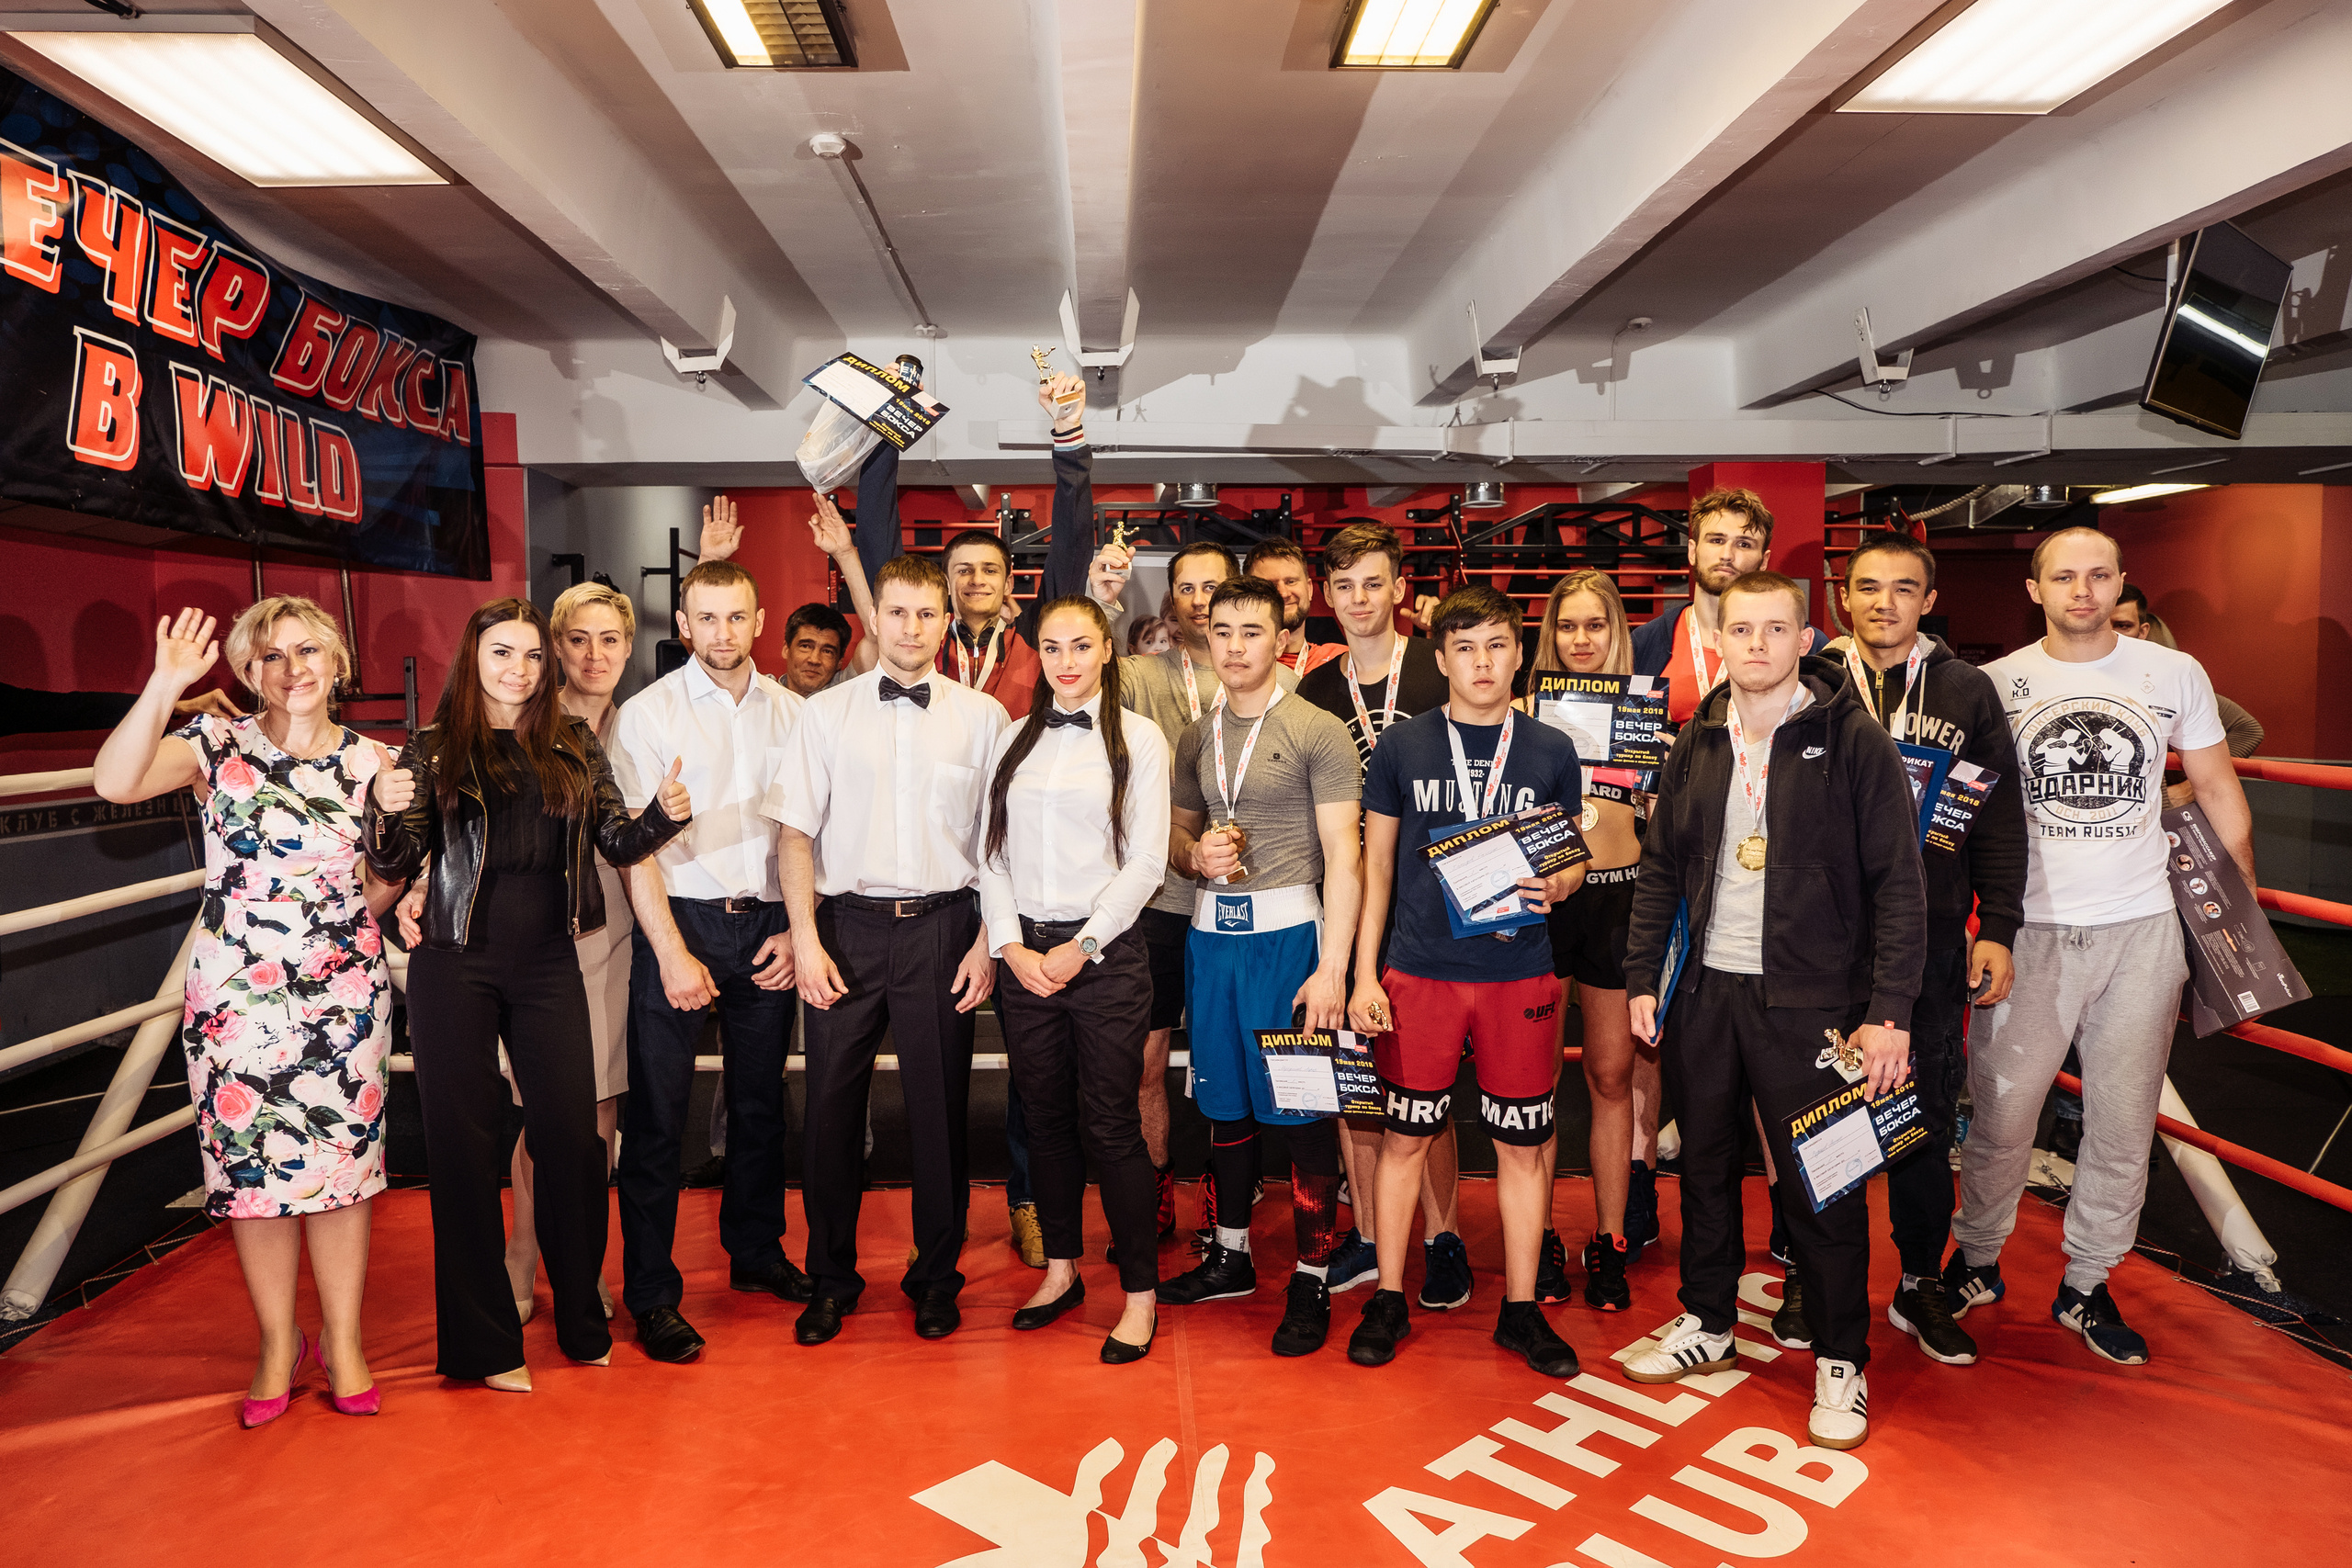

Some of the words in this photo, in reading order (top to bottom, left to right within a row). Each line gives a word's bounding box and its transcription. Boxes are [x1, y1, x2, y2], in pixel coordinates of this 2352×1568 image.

[270, 286, 471, 447] БОКСА
[842, 355, 910, 393] ДИПЛОМ
[66, 325, 143, 471] В
[169, 360, 362, 525] WILD
[880, 411, 915, 439] БОКСА
[887, 404, 923, 432] ВЕЧЕР
[1540, 677, 1620, 694] ДИПЛОМ
[1615, 720, 1662, 731] ВЕЧЕР
[2022, 701, 2111, 740] БОКСЕРСКИЙ
[2116, 709, 2150, 738] КЛУБ
[1615, 732, 1661, 743] БОКСА
[1806, 746, 1825, 754] NIKE
[1413, 779, 1535, 816] MUTNG
[1589, 784, 1623, 799] ARD
[1939, 789, 1955, 798] мая
[1957, 795, 1980, 807] 2018
[2030, 774, 2143, 800] УДАРНИК
[1934, 802, 1973, 820] ЕЧЕР
[1521, 819, 1568, 845] ВЕЧЕР
[1931, 814, 1965, 832] КСА
[2041, 825, 2076, 838] TEAM
[1427, 819, 1510, 858] ДИПЛОМ
[1526, 829, 1576, 854] БОКСА
[1586, 870, 1623, 885] GYM
[1217, 901, 1250, 922] EVERLAST
[1261, 1034, 1332, 1048] ДИПЛОМ
[1338, 1072, 1376, 1083] ВЕЧЕР
[1894, 1081, 1915, 1095] 2018
[1340, 1084, 1380, 1095] БОКСА
[1791, 1082, 1868, 1138] ДИПЛОМ
[1875, 1094, 1917, 1125] ВЕЧЕР
[1879, 1107, 1922, 1136] БОКСА
[1545, 1426, 1869, 1568] LUB
